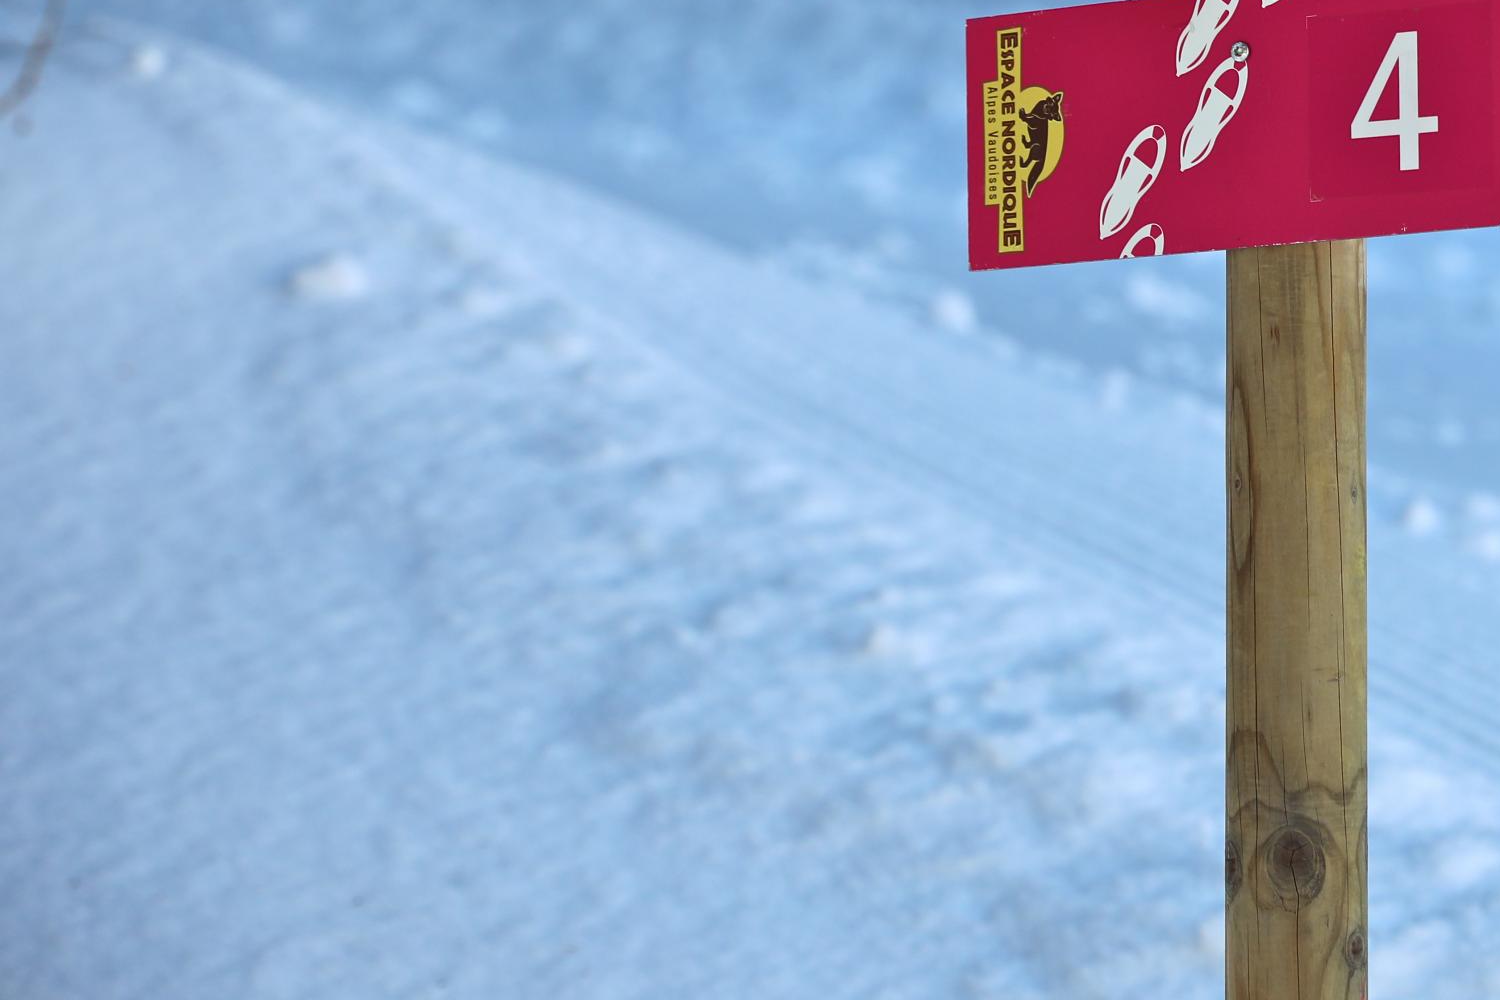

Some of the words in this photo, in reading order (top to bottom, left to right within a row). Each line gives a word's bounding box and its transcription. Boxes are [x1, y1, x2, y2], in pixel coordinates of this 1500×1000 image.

[986, 86, 998, 124] Alpes
[1000, 31, 1019, 115] ESPACE
[1350, 31, 1439, 171] 4
[987, 131, 999, 201] Vaudoises
[1001, 120, 1022, 247] NORDIQUE
